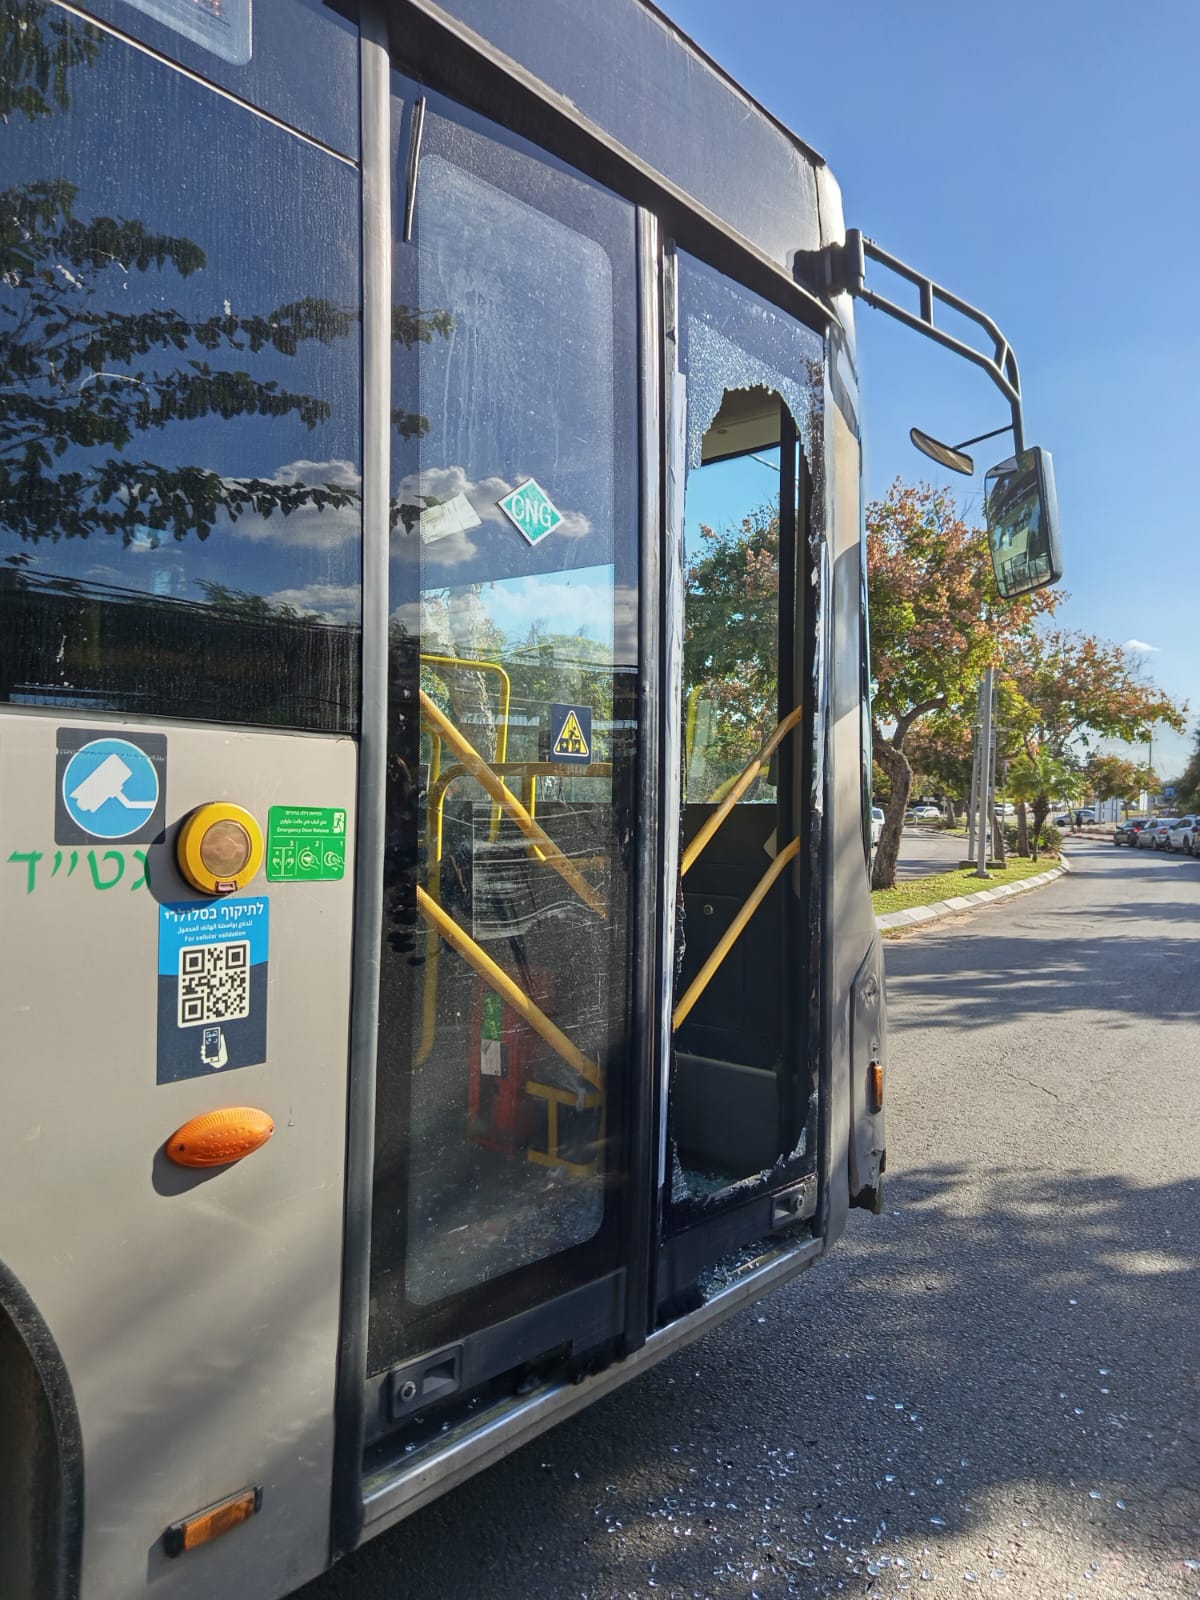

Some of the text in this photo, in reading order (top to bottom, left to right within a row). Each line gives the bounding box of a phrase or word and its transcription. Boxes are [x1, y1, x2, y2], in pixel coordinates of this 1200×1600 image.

[511, 495, 552, 528] CNG
[165, 902, 264, 922] לתיקוף בסלולרי
[184, 935, 195, 943] For
[196, 933, 217, 941] cellular
